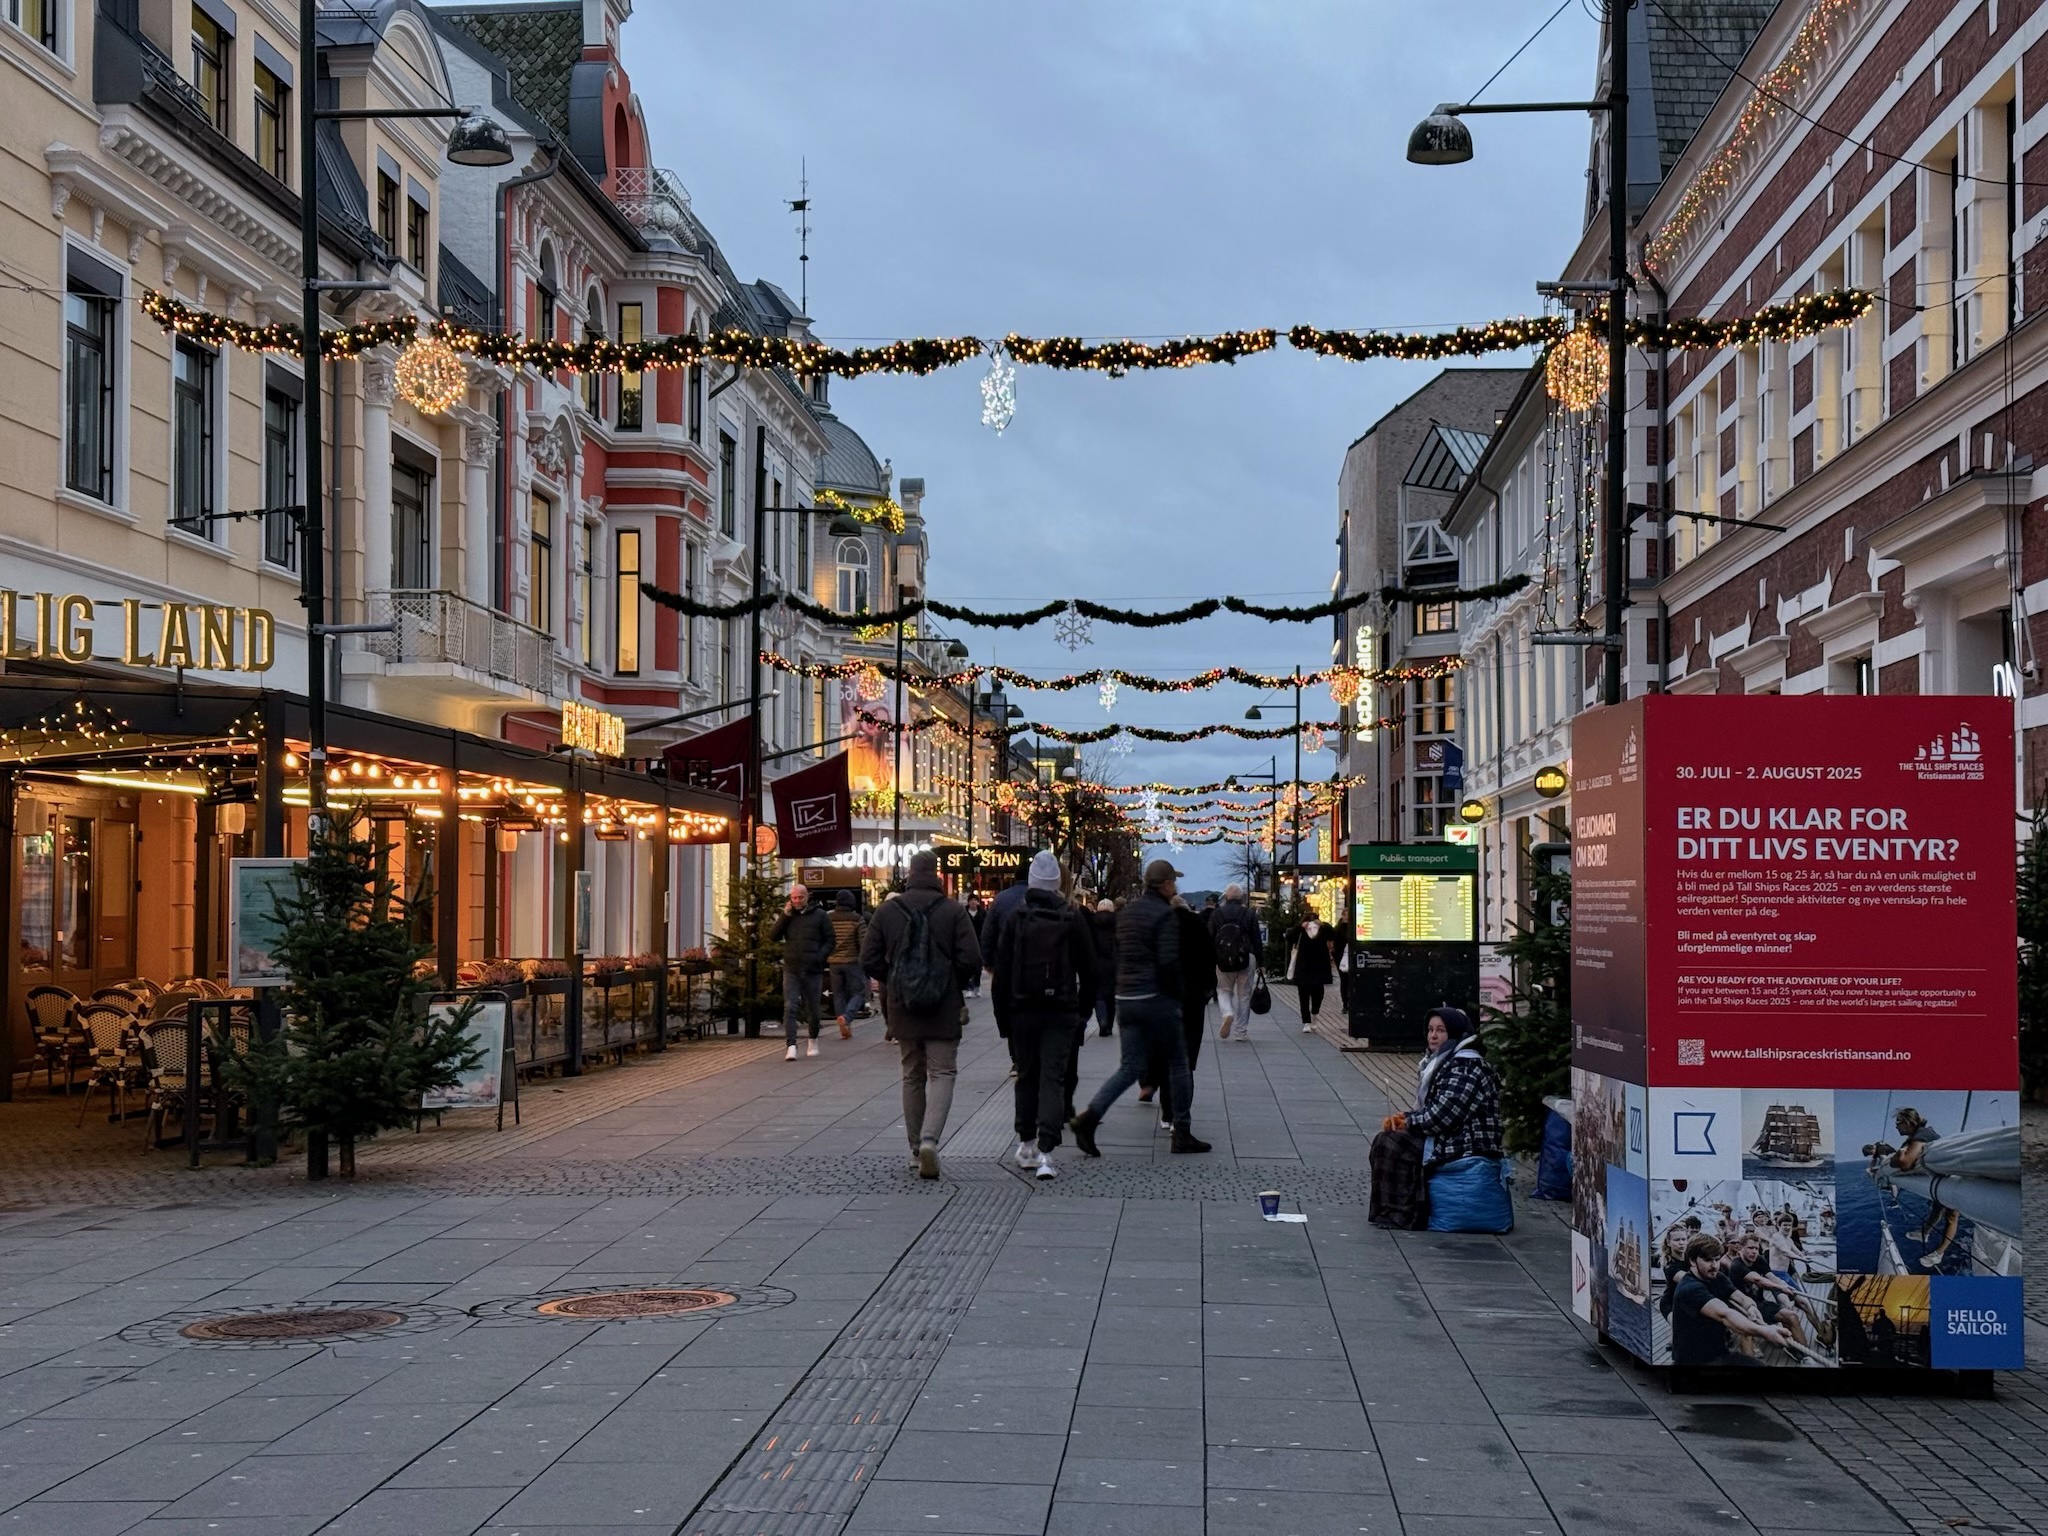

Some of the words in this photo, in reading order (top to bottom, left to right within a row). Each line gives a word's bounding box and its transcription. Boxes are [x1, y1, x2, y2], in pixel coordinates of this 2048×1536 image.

[0, 590, 95, 664] LIG
[124, 598, 275, 672] LAND
[1676, 766, 1697, 779] 30.
[1699, 766, 1730, 779] JULI
[1746, 766, 1759, 779] 2.
[1761, 766, 1824, 779] AUGUST
[1826, 766, 1862, 779] 2025
[1898, 762, 1913, 770] THE
[1914, 762, 1932, 771] TALL
[1934, 762, 1957, 771] SHIPS
[1958, 762, 1984, 771] RACES
[1536, 773, 1564, 788] nille
[1917, 771, 1965, 780] Kristiansand
[1966, 771, 1984, 780] 2025
[1677, 807, 1712, 829] ER
[1719, 807, 1760, 830] DU
[1769, 807, 1844, 830] KLAR
[1850, 807, 1908, 830] FOR
[1576, 812, 1617, 839] VELKOMMEN
[1576, 846, 1586, 867] OM
[1587, 844, 1608, 867] BORD!
[1677, 837, 1743, 859] DITT
[1748, 837, 1807, 860] LIVS
[1815, 838, 1959, 861] EVENTYR?
[1380, 854, 1406, 863] Public
[1408, 854, 1448, 864] transport
[1676, 869, 1698, 879] Hvis
[1700, 869, 1713, 879] du
[1714, 871, 1726, 879] er
[1727, 869, 1762, 879] mellom
[1765, 869, 1778, 879] 15
[1779, 872, 1793, 881] og
[1794, 869, 1808, 879] 25
[1809, 869, 1822, 880] år,
[1824, 869, 1835, 879] så
[1836, 870, 1853, 879] har
[1854, 870, 1868, 880] du
[1869, 870, 1882, 880] nå
[1884, 872, 1897, 880] en
[1898, 870, 1920, 880] unik
[1921, 870, 1964, 882] mulighet
[1966, 870, 1976, 880] til
[1676, 881, 1683, 891] å
[1684, 881, 1696, 891] bli
[1698, 881, 1720, 891] med
[1722, 881, 1734, 893] på
[1735, 881, 1752, 891] Tall
[1754, 881, 1781, 893] Ships
[1782, 882, 1811, 891] Races
[1812, 882, 1838, 892] 2025
[1849, 884, 1862, 892] en
[1864, 884, 1876, 892] av
[1877, 882, 1916, 892] verdens
[1917, 883, 1952, 893] største
[1676, 893, 1738, 905] seilregattaer!
[1740, 893, 1794, 905] Spennende
[1796, 894, 1846, 904] aktiviteter
[1848, 896, 1860, 906] og
[1862, 897, 1880, 906] nye
[1882, 894, 1928, 906] vennskap
[1930, 895, 1944, 905] fra
[1946, 895, 1967, 905] hele
[1676, 906, 1710, 915] verden
[1711, 906, 1743, 916] venter
[1745, 906, 1757, 917] på
[1759, 906, 1780, 918] deg.
[1677, 930, 1690, 940] Bli
[1692, 930, 1713, 940] med
[1716, 930, 1728, 942] på
[1730, 931, 1777, 942] eventyret
[1779, 933, 1792, 942] og
[1793, 931, 1817, 943] skap
[1677, 943, 1753, 954] uforglemmelige
[1755, 943, 1792, 953] minner!
[1677, 975, 1695, 984] ARE
[1695, 975, 1715, 984] YOU
[1716, 975, 1746, 984] READY
[1747, 976, 1765, 984] FOR
[1766, 976, 1784, 985] THE
[1784, 976, 1838, 985] ADVENTURE
[1839, 977, 1852, 985] OF
[1853, 977, 1879, 985] YOUR
[1880, 977, 1902, 985] LIFE?
[1677, 986, 1684, 994] If
[1684, 987, 1700, 995] you
[1715, 986, 1749, 995] between
[1751, 986, 1761, 995] 15
[1762, 987, 1778, 995] and
[1779, 986, 1790, 995] 25
[1791, 988, 1812, 996] years
[1813, 987, 1828, 996] old,
[1829, 989, 1844, 997] you
[1864, 988, 1884, 996] have
[1891, 987, 1919, 997] unique
[1919, 988, 1966, 998] opportunity
[1967, 989, 1976, 997] to
[1677, 996, 1692, 1005] join
[1694, 996, 1707, 1004] the
[1708, 996, 1721, 1004] Tall
[1723, 996, 1744, 1006] Ships
[1745, 996, 1768, 1005] Races
[1770, 997, 1790, 1005] 2025
[1815, 997, 1825, 1005] of
[1826, 998, 1839, 1006] the
[1840, 998, 1869, 1006] world's
[1870, 998, 1896, 1007] largest
[1897, 998, 1922, 1008] sailing
[1923, 999, 1957, 1008] regattas!
[1710, 1047, 1911, 1061] www.tallshipsraceskristiansand.no
[1948, 1310, 1997, 1322] HELLO
[1947, 1322, 2007, 1336] SAILOR!
